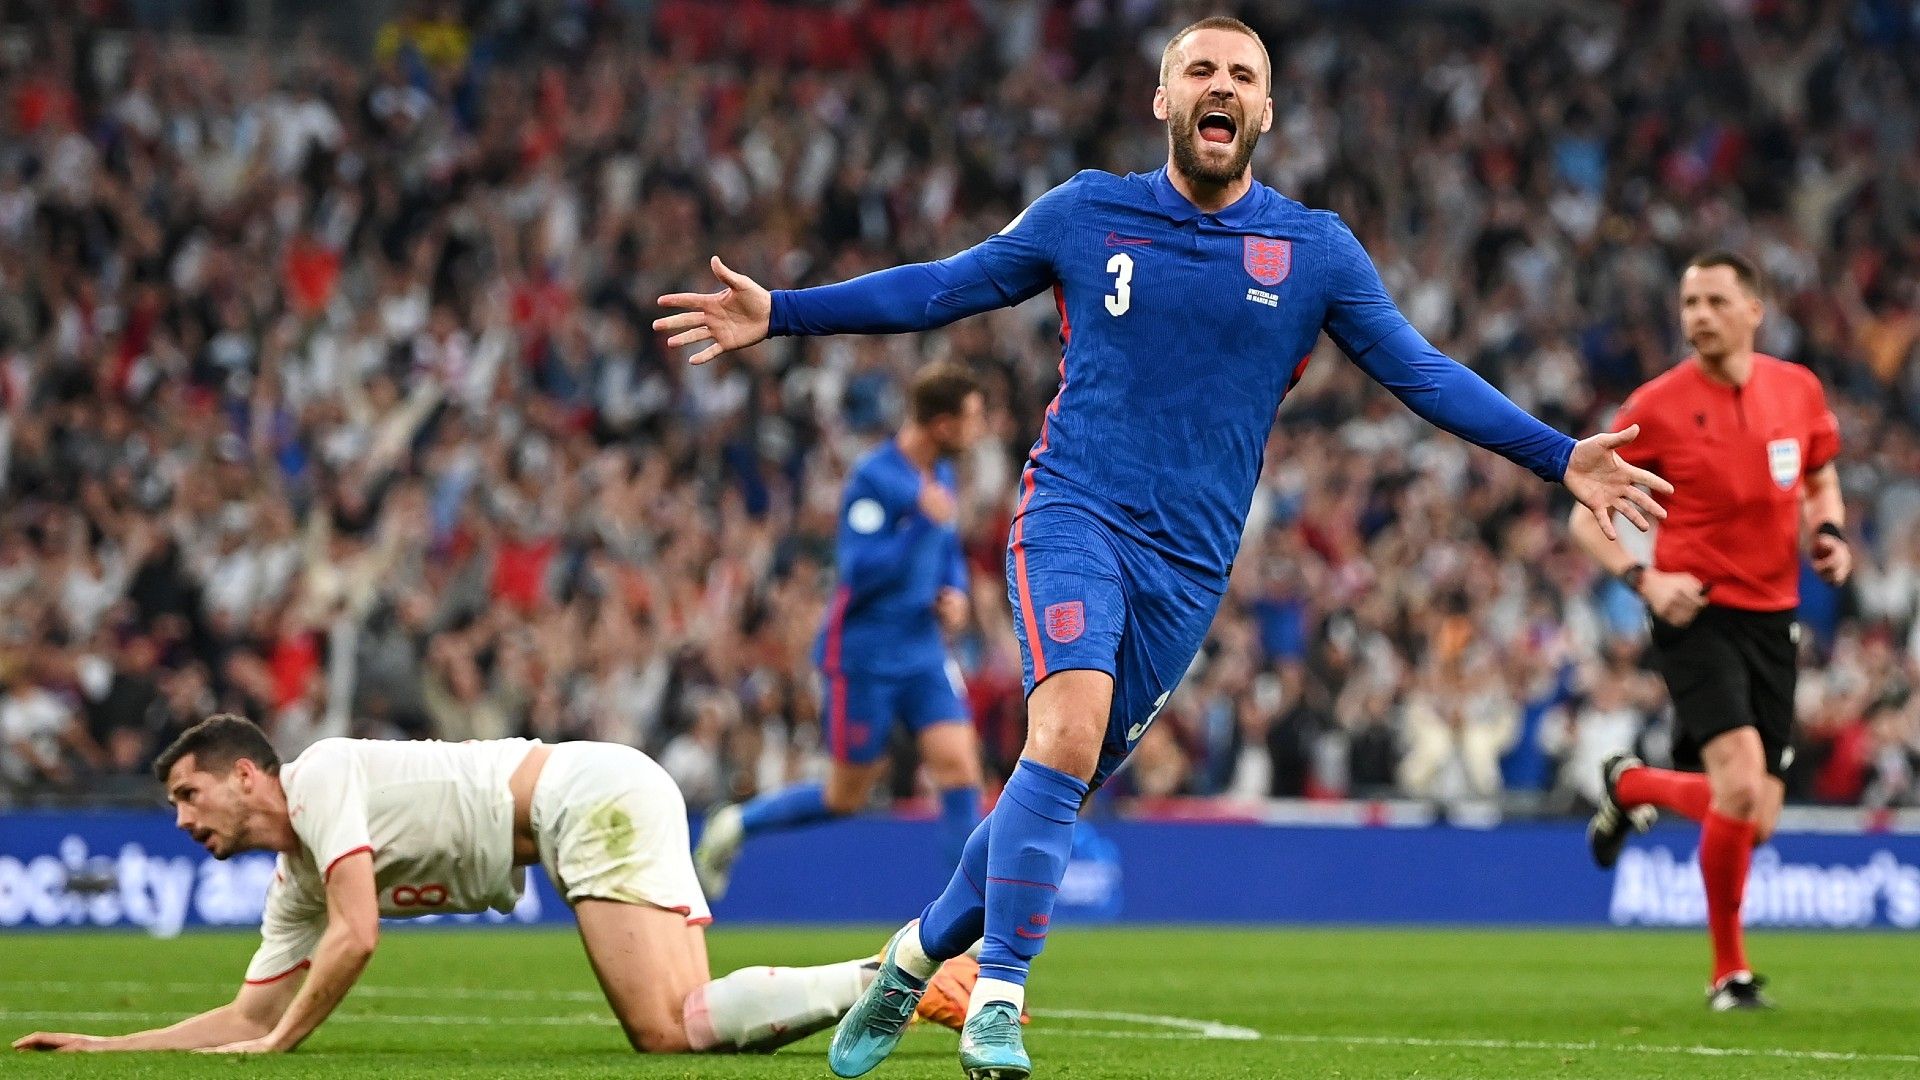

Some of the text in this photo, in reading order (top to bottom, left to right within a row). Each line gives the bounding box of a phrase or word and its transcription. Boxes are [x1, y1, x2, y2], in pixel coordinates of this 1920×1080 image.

[1104, 252, 1134, 317] 3
[1127, 689, 1171, 741] 3
[392, 882, 448, 908] 8
